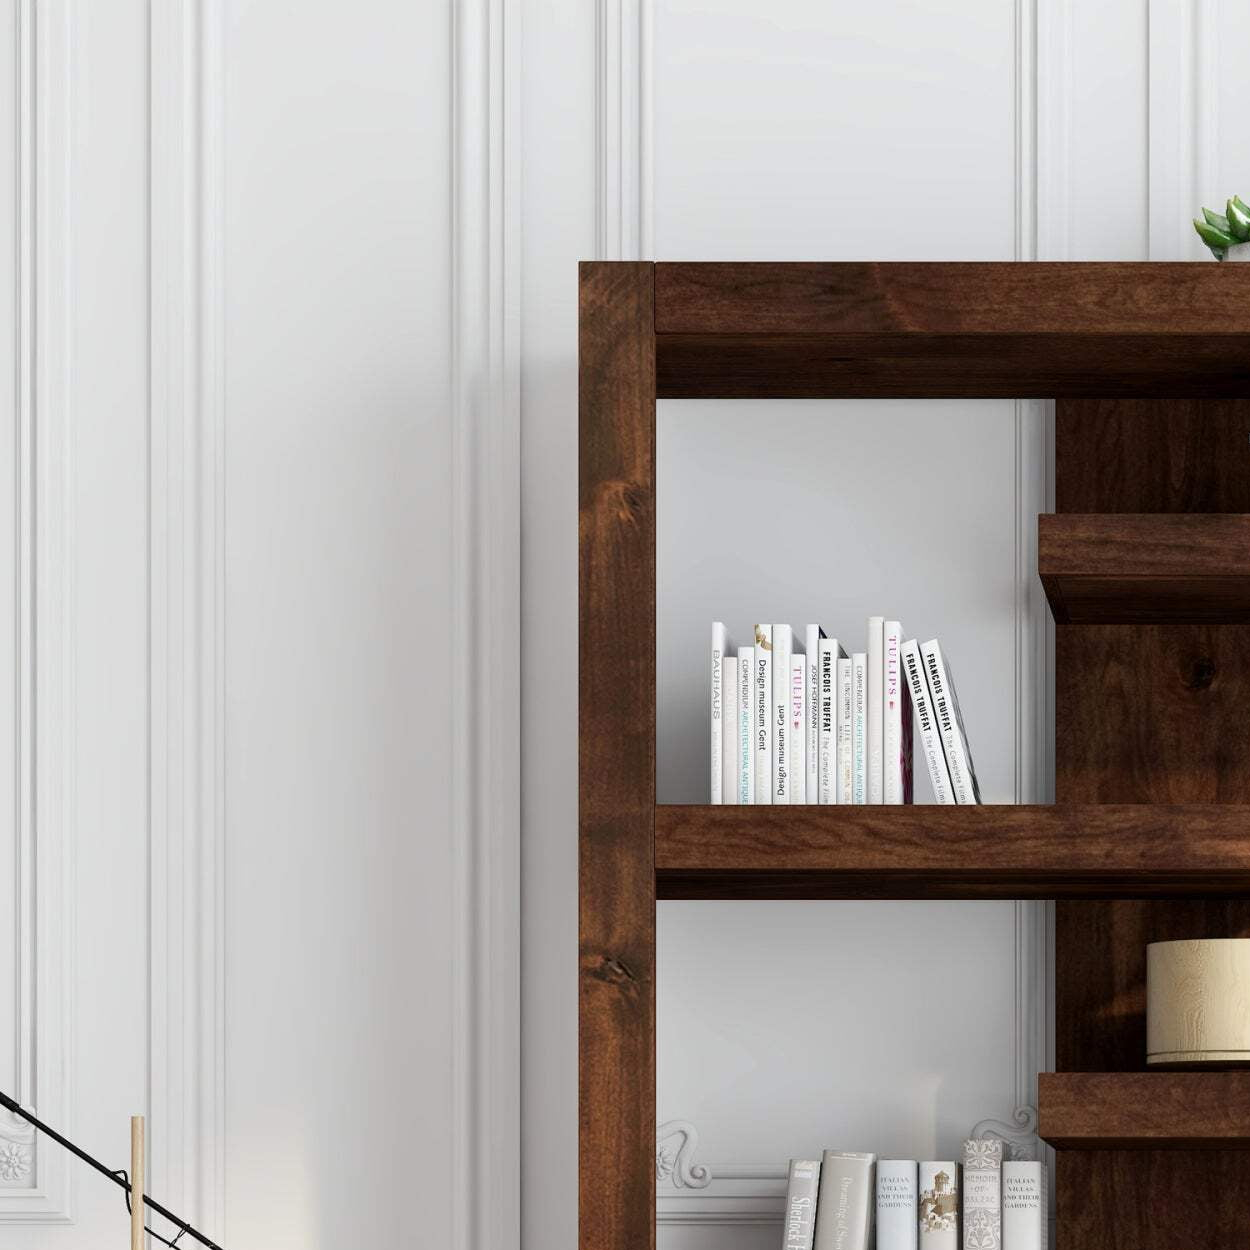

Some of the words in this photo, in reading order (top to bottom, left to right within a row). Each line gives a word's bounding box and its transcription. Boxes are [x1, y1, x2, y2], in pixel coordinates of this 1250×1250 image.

[757, 659, 767, 689] Design
[822, 651, 831, 693] FRANCOIS
[888, 636, 896, 696] TULIPS
[792, 666, 802, 717] TULIPS
[906, 653, 920, 694] FRANCOIS
[916, 697, 931, 732] TRUFFAT
[926, 653, 942, 694] FRANCOIS
[936, 697, 952, 732] TRUFFAT
[777, 704, 785, 726] Gent
[822, 696, 831, 732] TRUFFAT
[759, 730, 767, 751] Gent
[777, 766, 787, 796] Design
[788, 1196, 811, 1241] Sherlock
